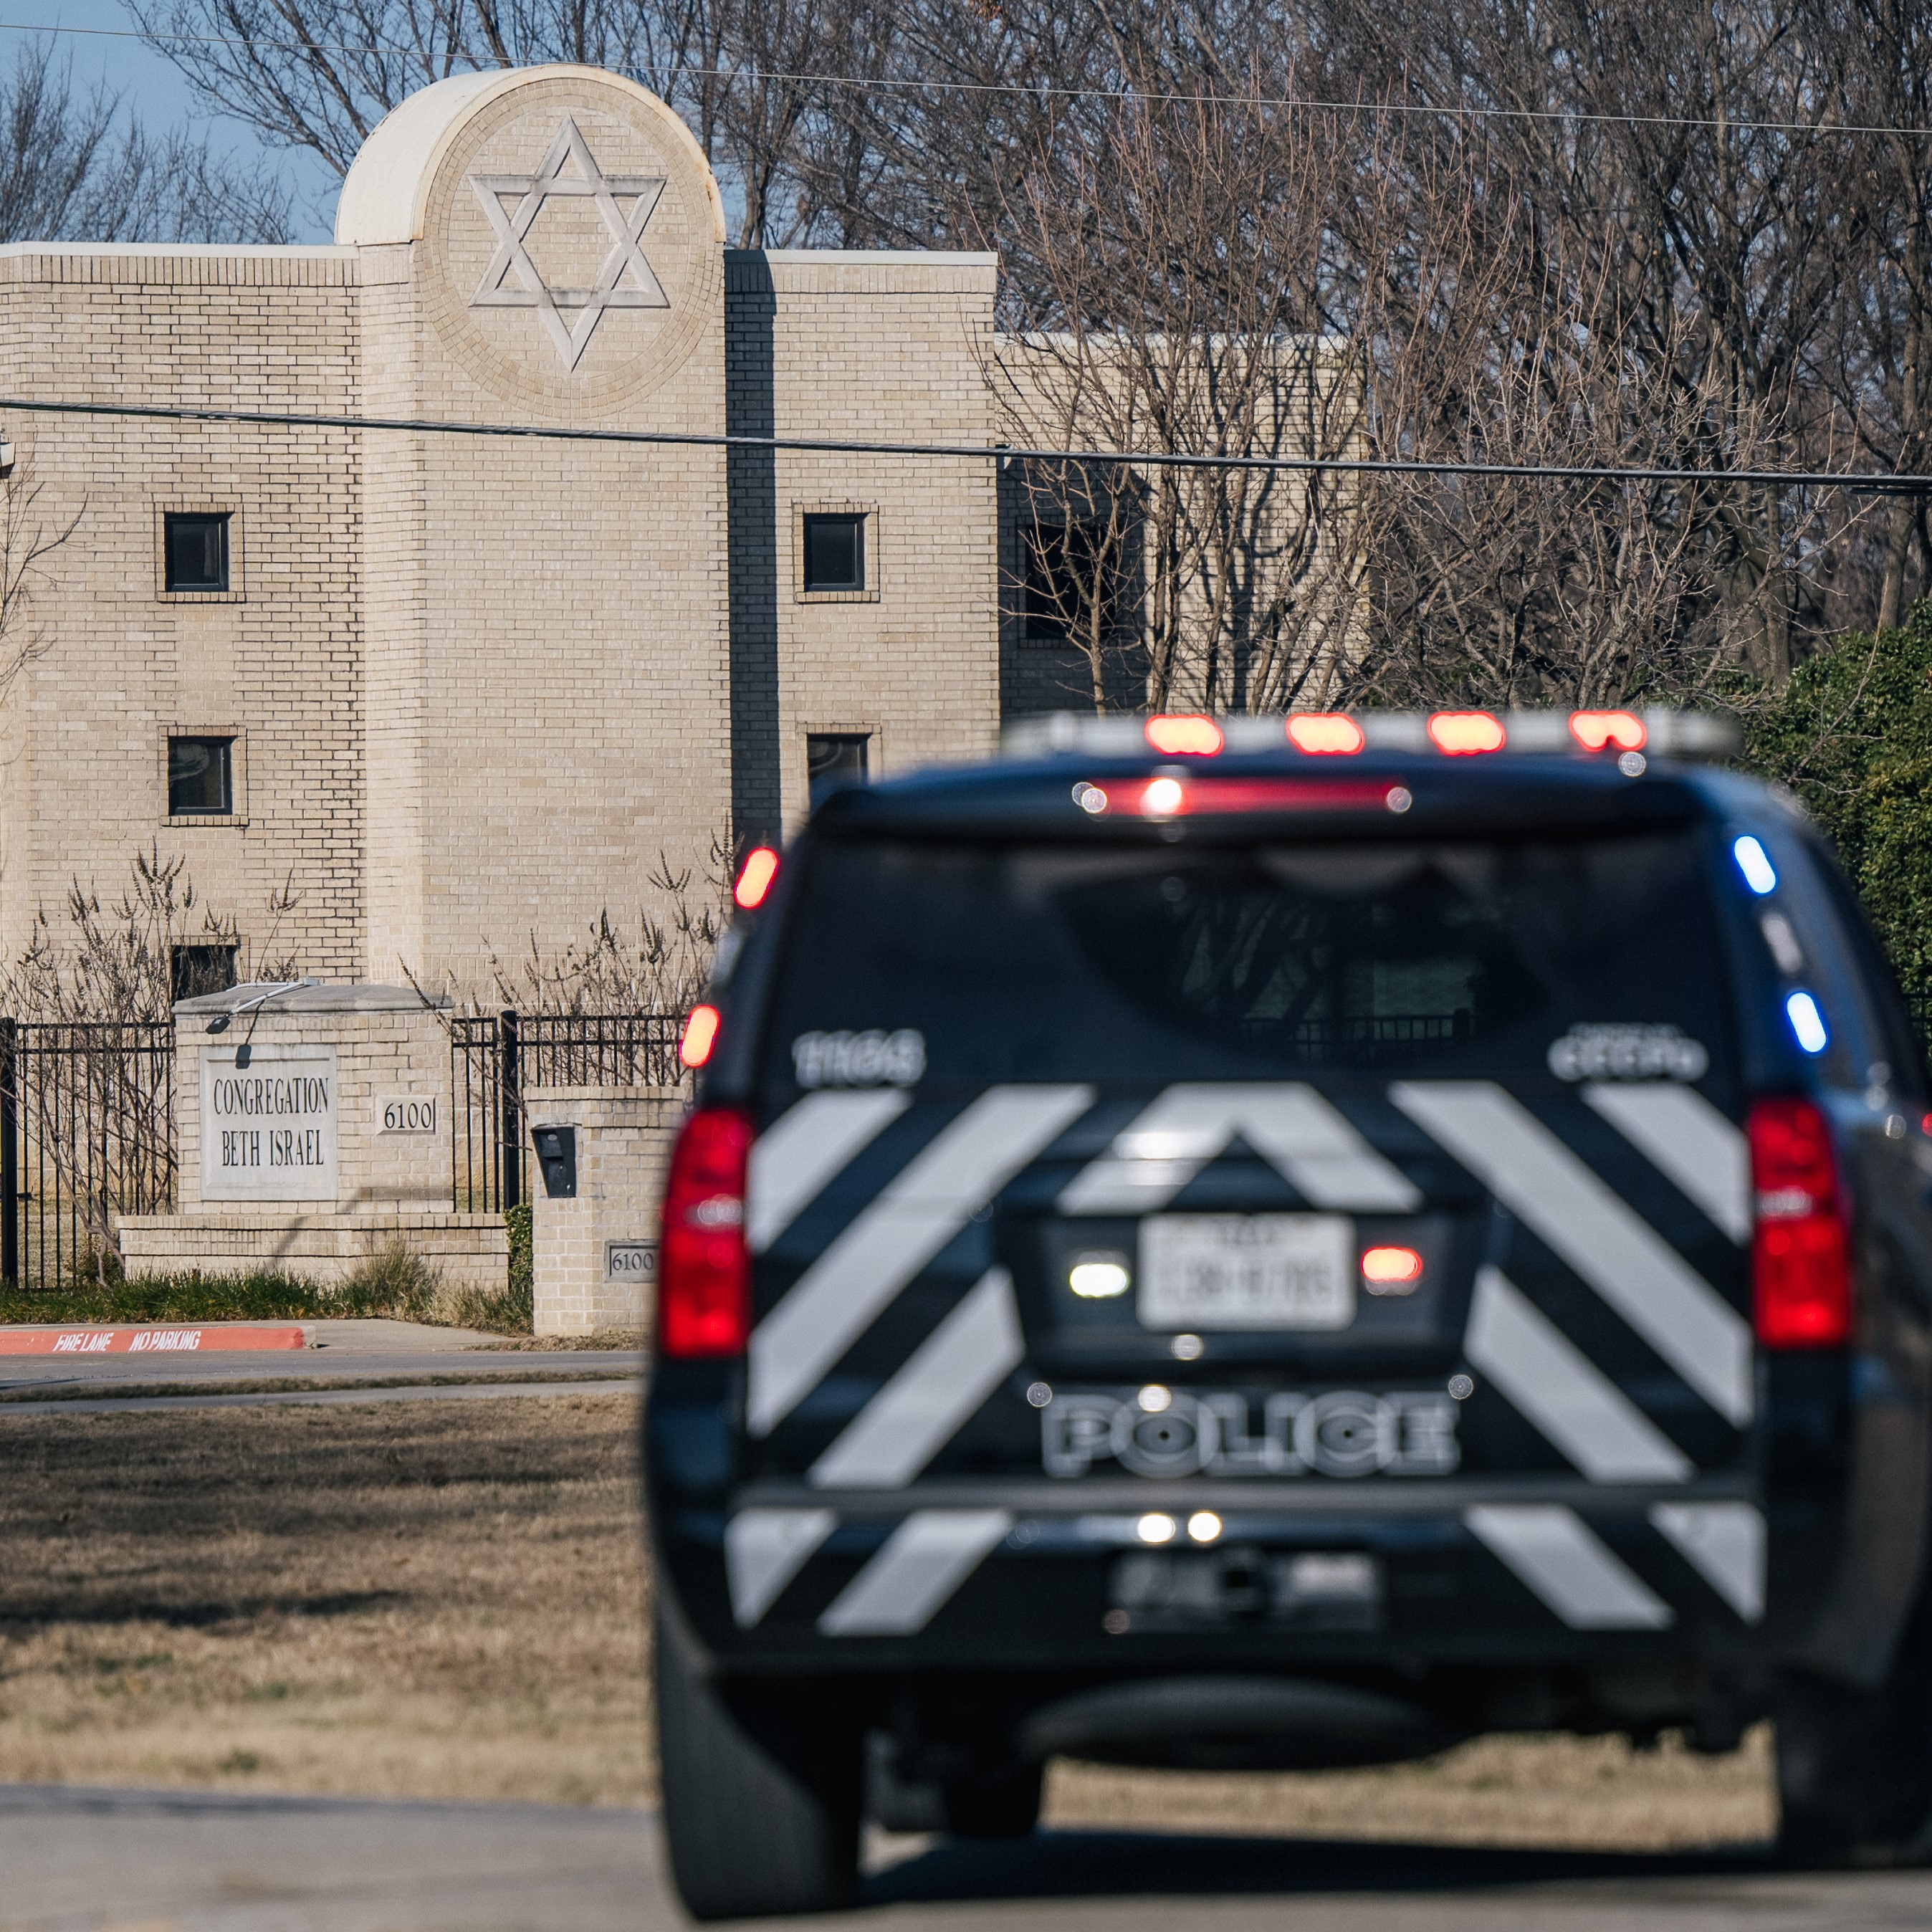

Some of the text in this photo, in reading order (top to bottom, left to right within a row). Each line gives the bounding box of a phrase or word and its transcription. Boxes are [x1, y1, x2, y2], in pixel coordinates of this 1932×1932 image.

[214, 1078, 329, 1115] CONGREGATION
[384, 1102, 431, 1129] 6100
[222, 1129, 324, 1167] BETH ISRAEL
[612, 1253, 654, 1271] 6100
[52, 1331, 201, 1352] FIRE LANE NO PARKING
[1041, 1391, 1460, 1478] POLICE
